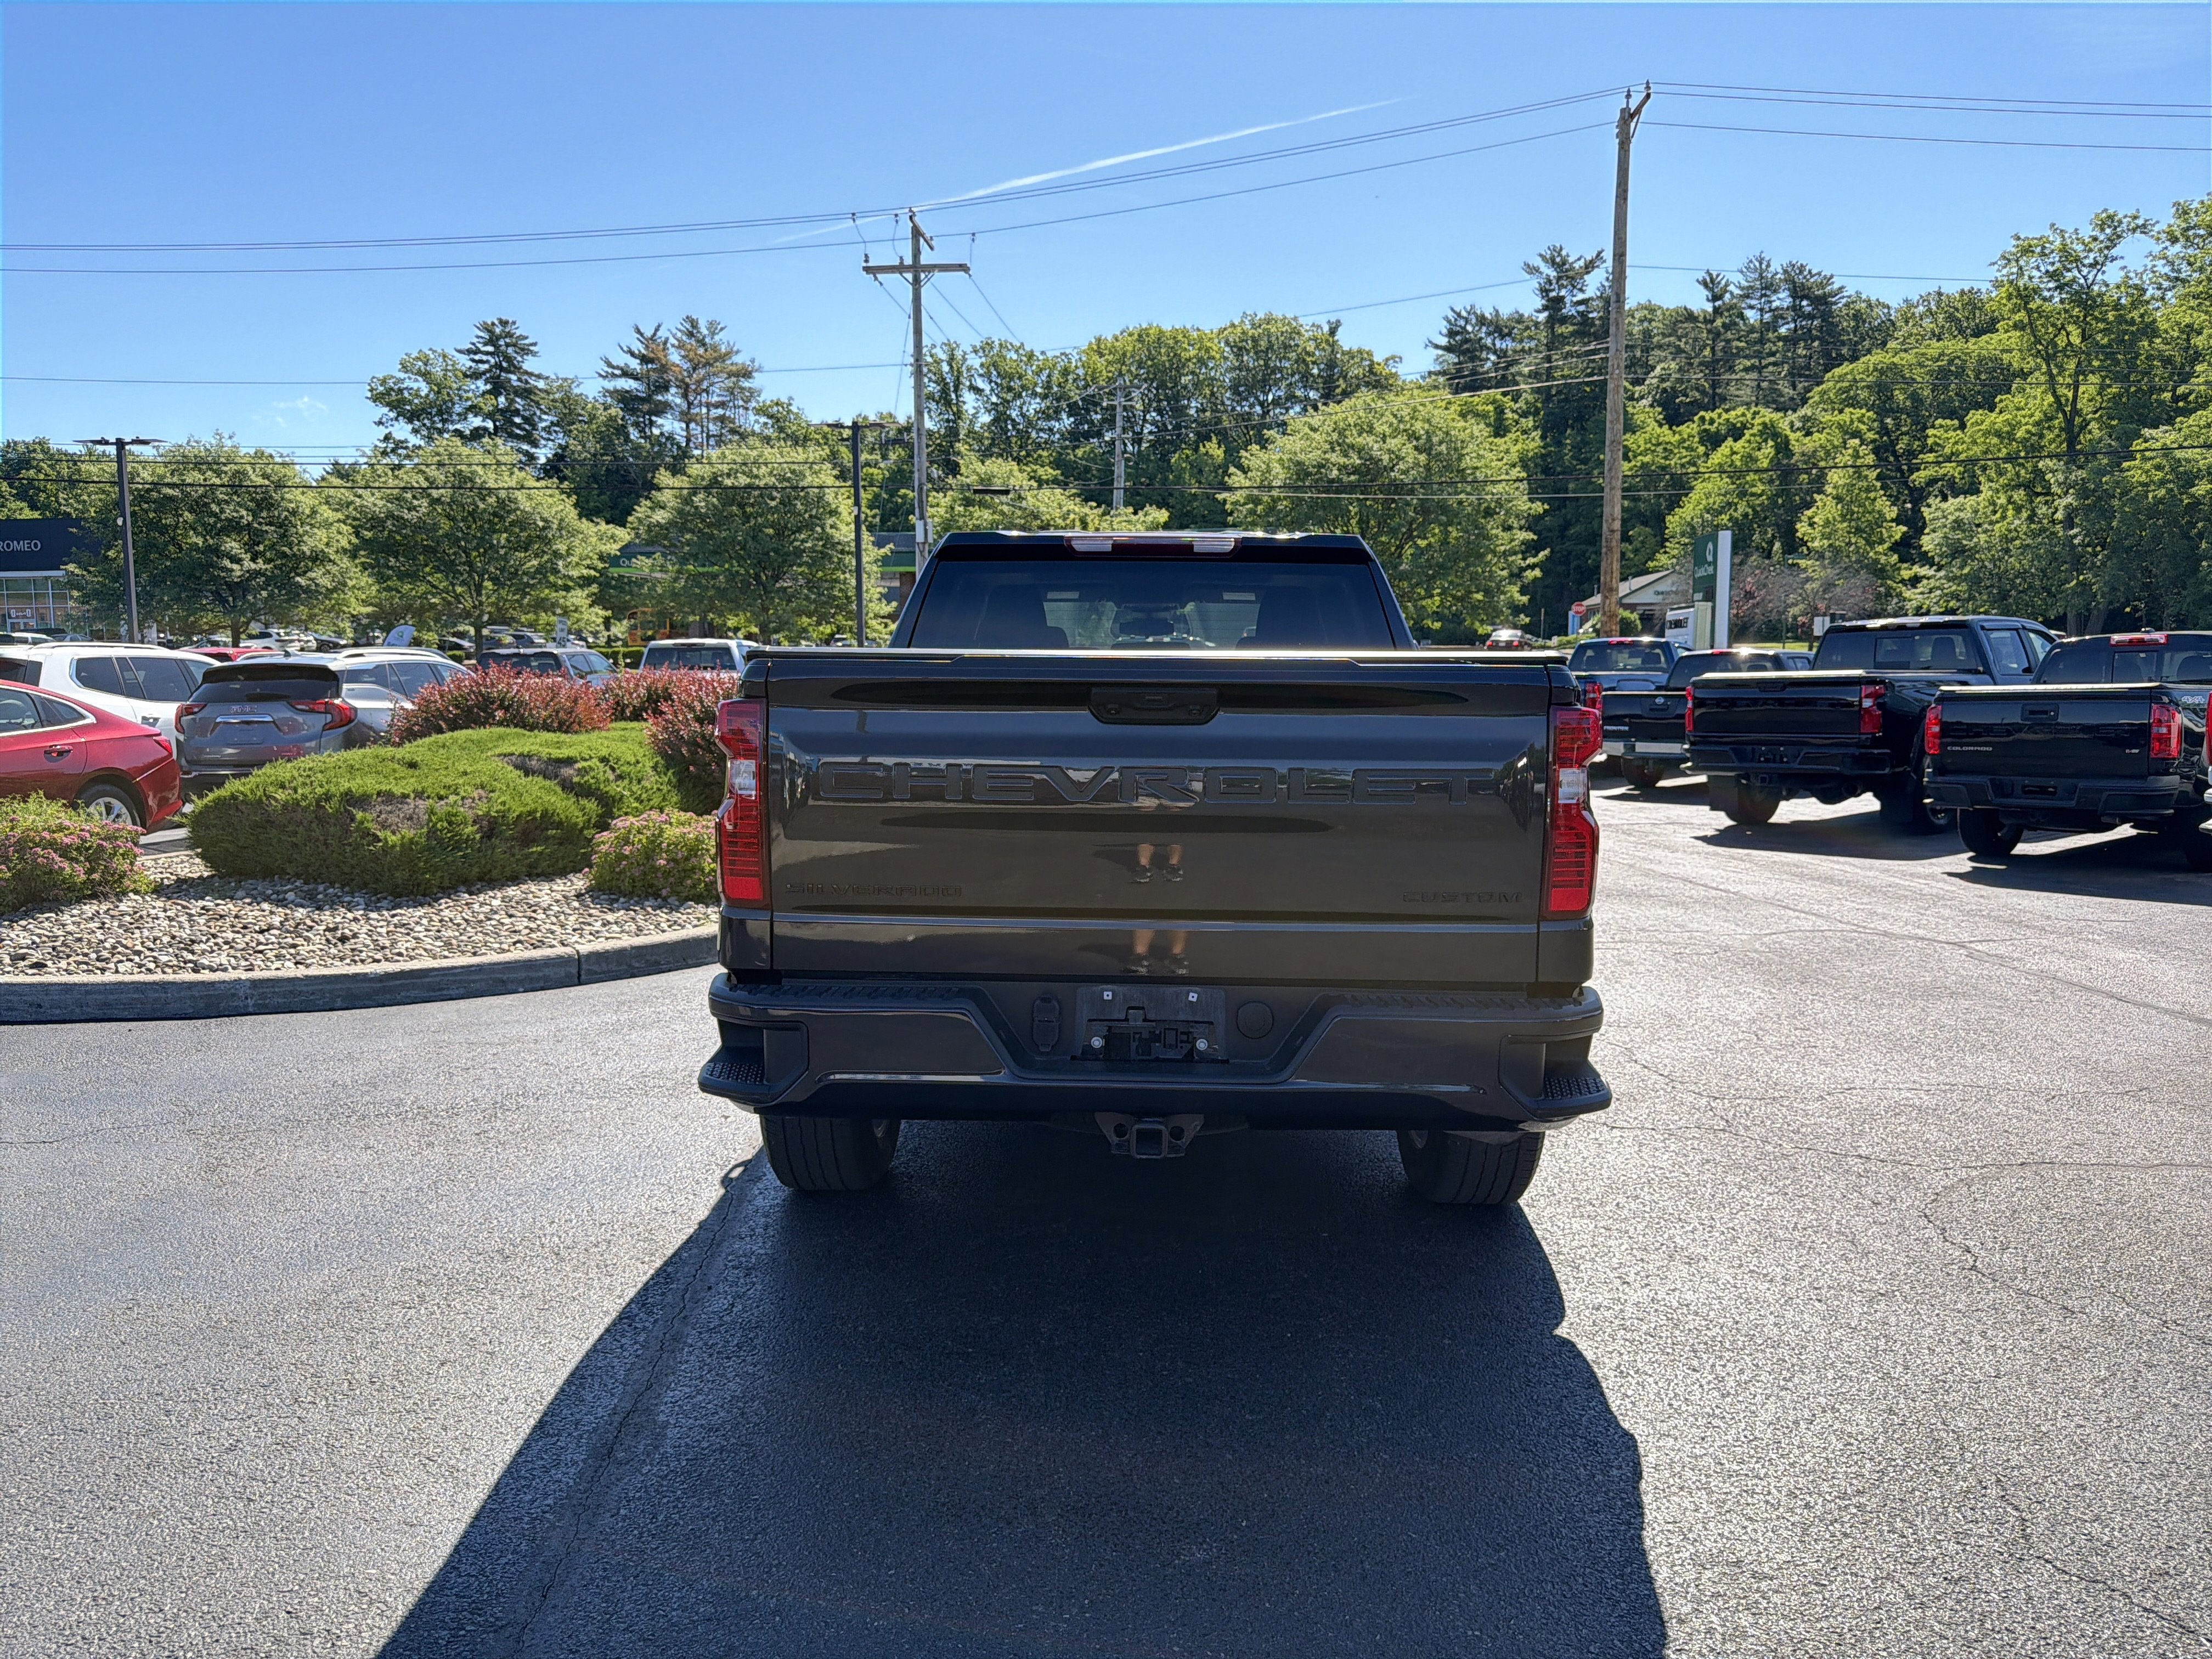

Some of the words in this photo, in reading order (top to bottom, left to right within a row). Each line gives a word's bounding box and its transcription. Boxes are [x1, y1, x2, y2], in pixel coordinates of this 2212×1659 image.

[557, 636, 566, 647] 45
[230, 705, 257, 713] GMC
[820, 762, 1494, 805] CHEVROLET
[786, 883, 962, 897] SILVERADO
[1402, 891, 1523, 903] CUSTOM
